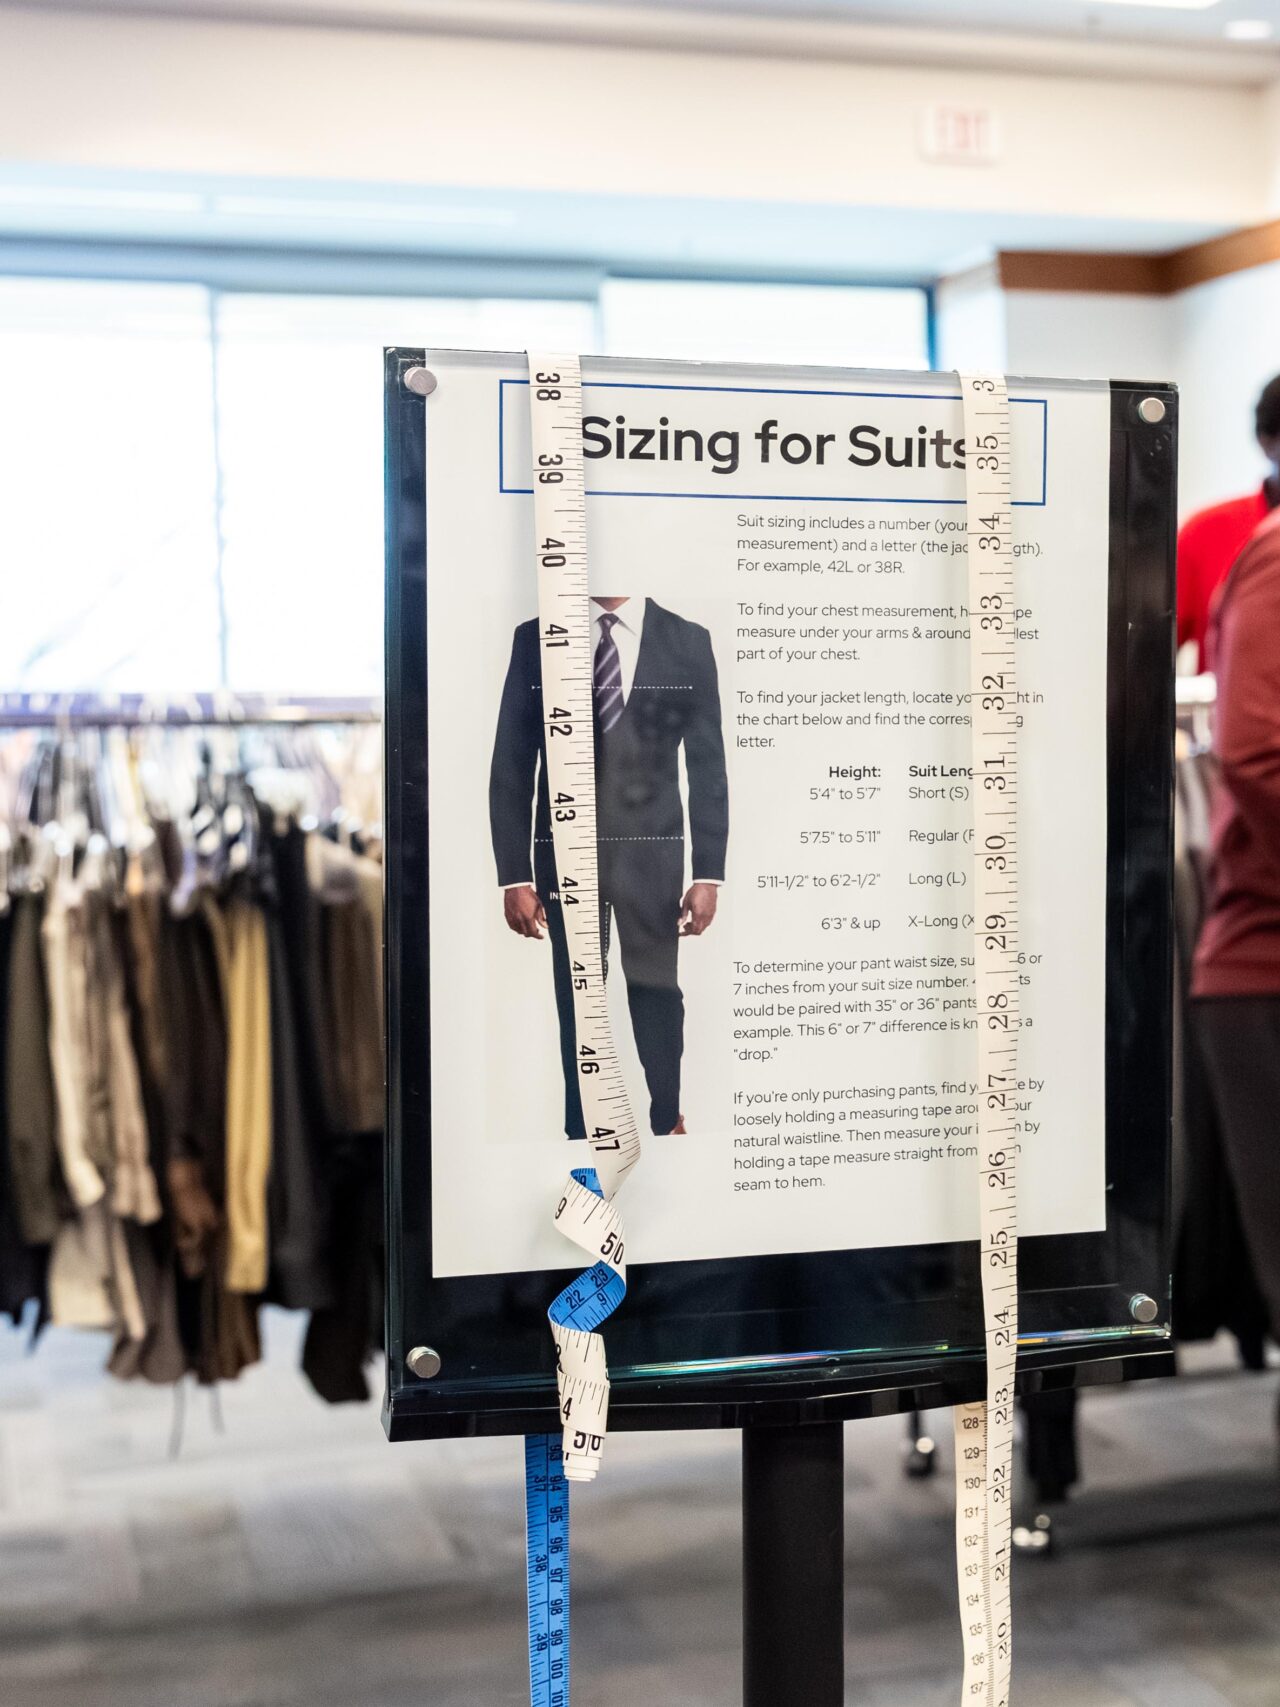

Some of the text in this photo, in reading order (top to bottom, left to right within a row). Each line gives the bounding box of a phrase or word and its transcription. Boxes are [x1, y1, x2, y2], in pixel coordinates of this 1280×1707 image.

[582, 415, 967, 475] Sizing for Suits
[737, 514, 969, 535] Suit sizing includes a number (your
[737, 538, 949, 555] measurement) and a letter (the
[738, 559, 904, 575] For example, 42L or 38R.
[737, 603, 754, 615] To
[757, 602, 784, 616] find
[787, 607, 818, 619] your
[822, 604, 859, 616] chest
[862, 606, 957, 620] measurement,
[737, 625, 971, 641] measure under your arms & around
[737, 646, 860, 663] part of your chest.
[737, 690, 1043, 707] To find your jacket length, locate in
[736, 712, 926, 725] the chart below and find the
[737, 735, 775, 747] letter.
[829, 765, 881, 781] Height:
[909, 765, 938, 777] Suit
[839, 788, 853, 800] to
[909, 785, 969, 802] Short (S)
[838, 832, 853, 843] to
[909, 829, 959, 844] Regular
[812, 876, 827, 887] to
[909, 872, 966, 887] Long (L)
[850, 917, 861, 929] &
[864, 920, 880, 931] up
[908, 915, 958, 929] X-Long
[733, 961, 751, 973] To
[753, 960, 824, 976] determine
[827, 961, 857, 974] your
[861, 958, 891, 972] pant
[894, 956, 927, 968] waist
[930, 955, 957, 968] size,
[1017, 951, 1026, 965] 6
[1029, 955, 1043, 964] or
[733, 976, 970, 995] 7 inches from your suit size number.
[733, 1003, 774, 1017] would
[777, 1003, 795, 1015] be
[799, 1000, 842, 1018] paired
[844, 1000, 871, 1013] with
[900, 1000, 914, 1011] or
[943, 996, 978, 1013] pants
[734, 1025, 793, 1040] example.
[797, 1024, 825, 1036] This
[846, 1025, 860, 1034] or
[879, 1018, 948, 1033] difference
[949, 1017, 960, 1030] is
[1025, 1018, 1032, 1027] a
[733, 1093, 744, 1105] If
[746, 1091, 788, 1108] you're
[791, 1088, 820, 1104] only
[823, 1085, 895, 1103] purchasing
[899, 1084, 938, 1099] pants,
[941, 1081, 966, 1094] find
[1029, 1078, 1044, 1092] by
[734, 1105, 952, 1127] loosely holding a measuring tape
[734, 1120, 1040, 1149] natural waistline. Then measure your by
[734, 1145, 978, 1170] holding a tape measure straight from
[734, 1176, 826, 1191] seam to hem.
